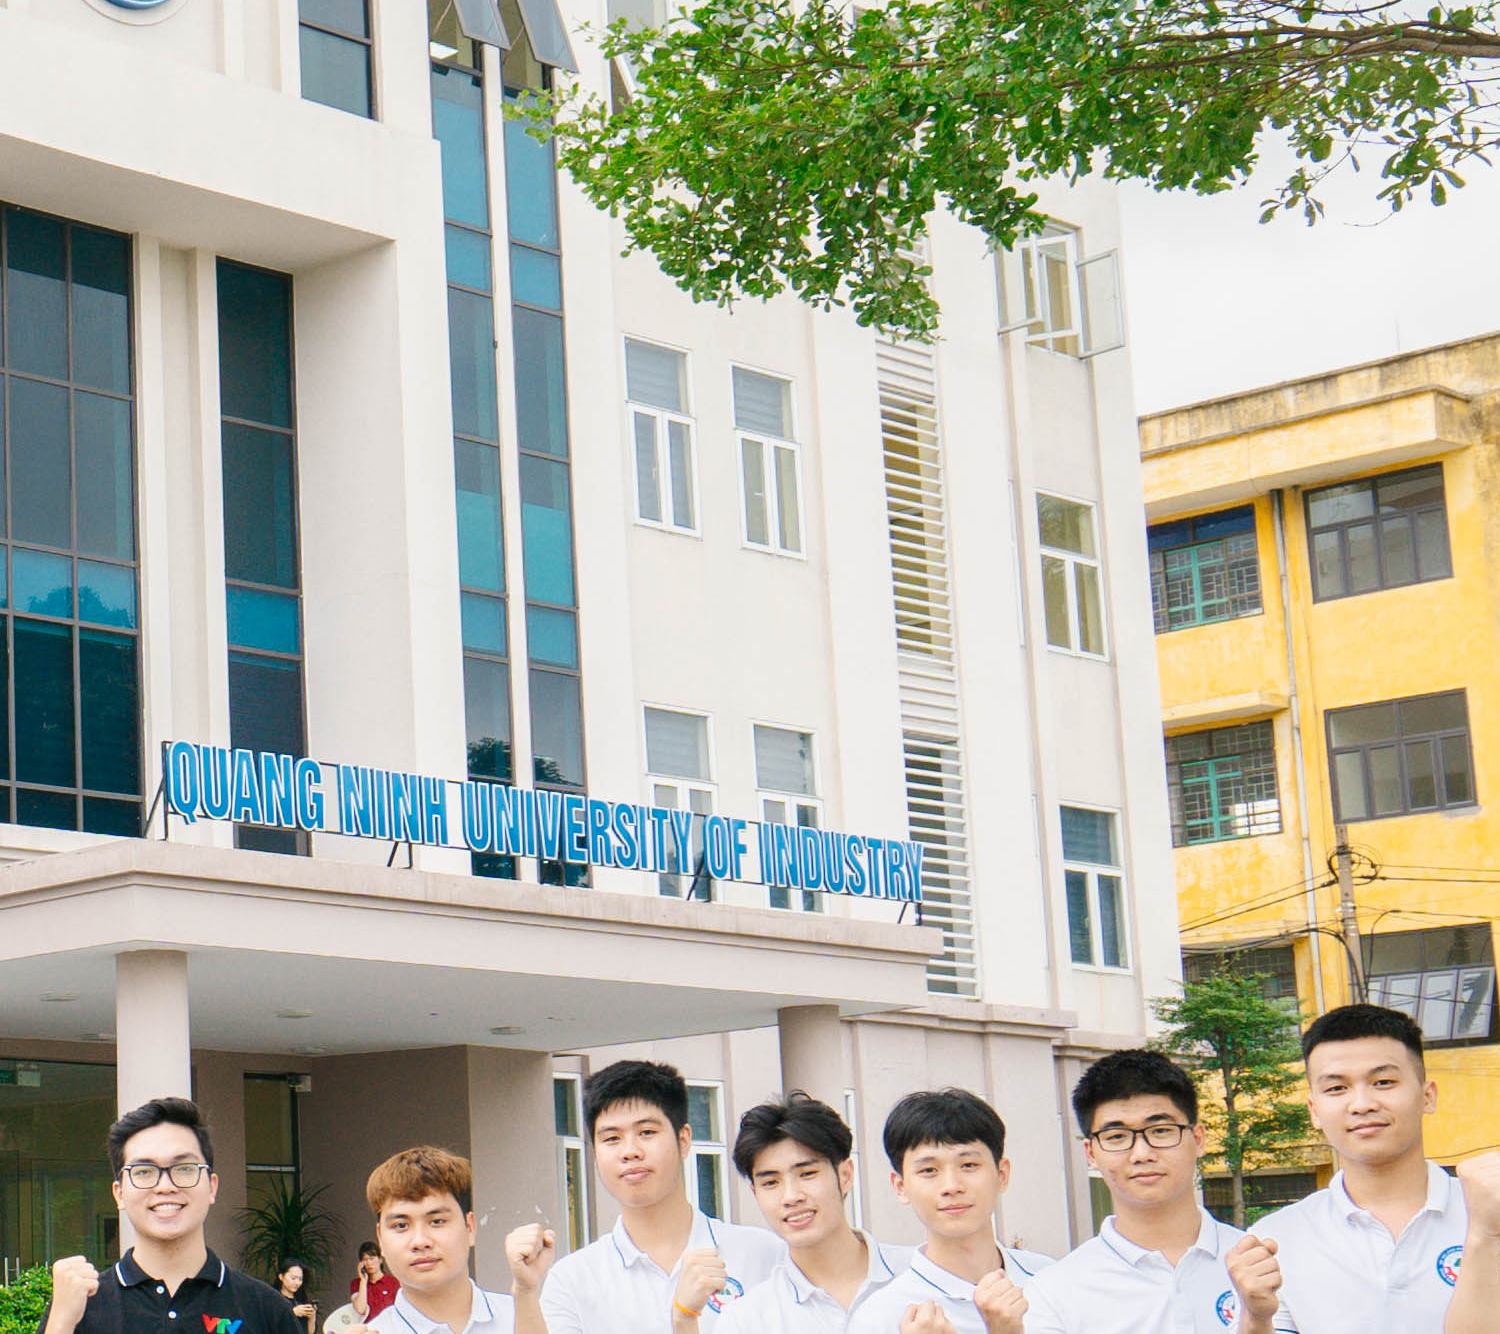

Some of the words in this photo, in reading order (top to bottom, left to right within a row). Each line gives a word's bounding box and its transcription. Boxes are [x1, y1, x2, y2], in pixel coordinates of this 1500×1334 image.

[165, 739, 326, 832] QUANG
[337, 763, 450, 847] NINH
[461, 780, 694, 876] UNIVERSITY
[703, 815, 751, 880] OF
[758, 821, 925, 903] INDUSTRY
